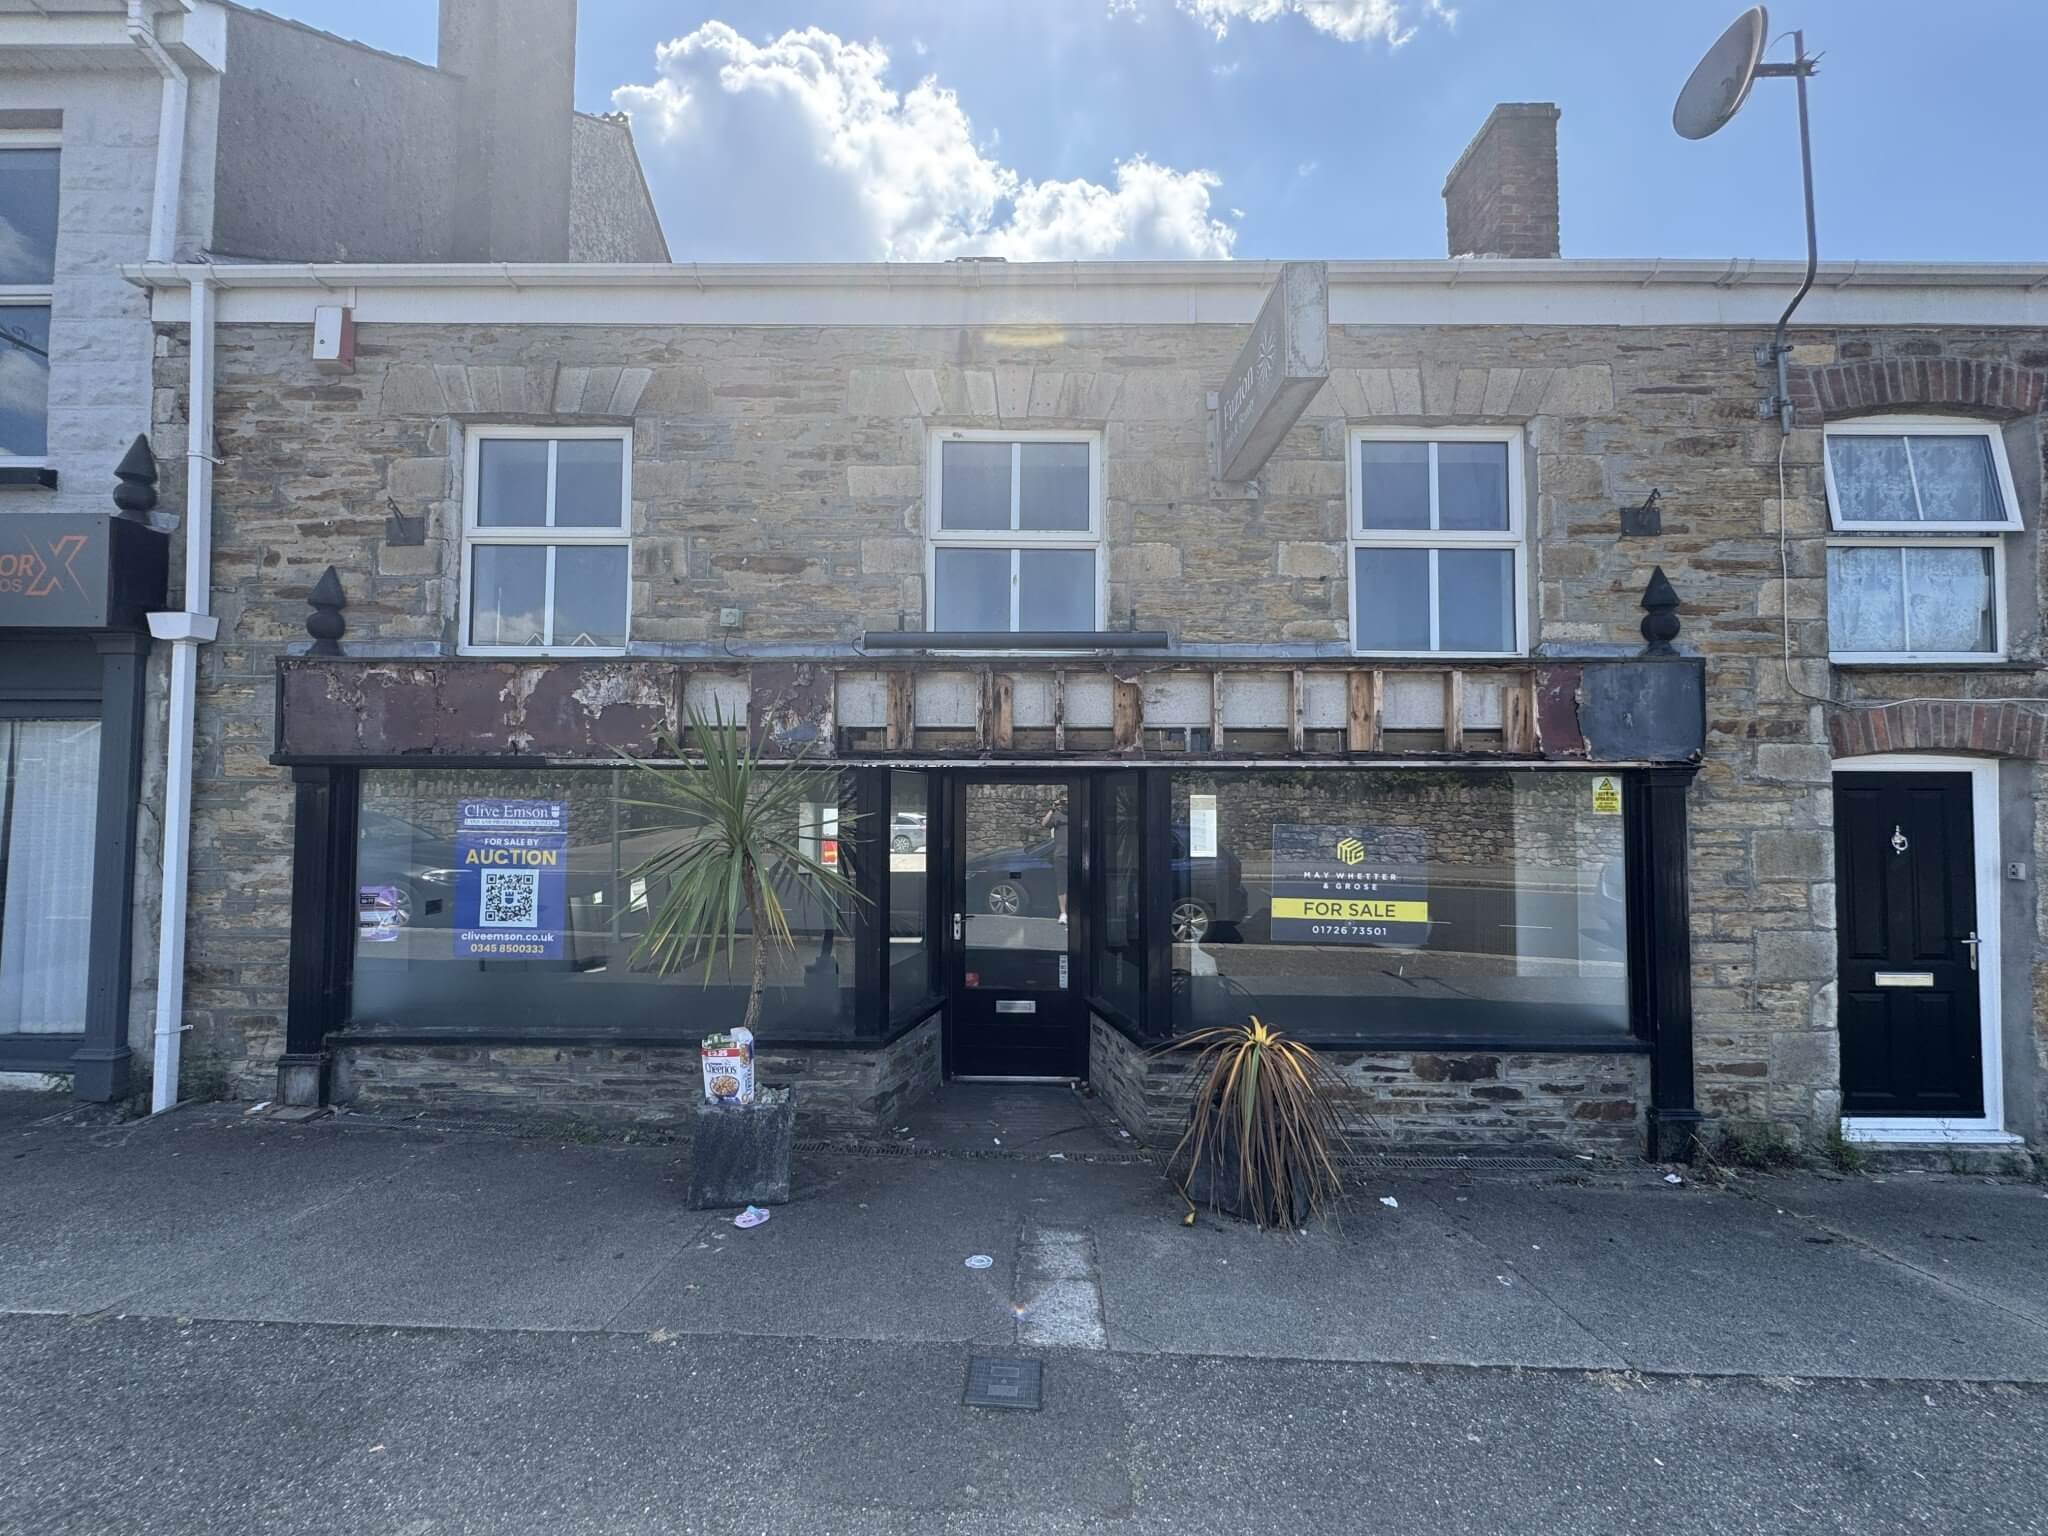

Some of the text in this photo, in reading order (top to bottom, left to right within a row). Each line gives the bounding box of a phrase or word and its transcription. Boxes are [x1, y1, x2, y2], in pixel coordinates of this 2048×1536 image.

[464, 804, 548, 818] Clive Emson
[484, 838, 539, 847] FOR SALE BY
[465, 849, 557, 865] AUCTION
[1303, 871, 1397, 881] MAY WHETTER
[1335, 883, 1378, 891] GROSE
[1304, 902, 1396, 918] FOR SALE
[1312, 925, 1387, 936] 01726 73501
[461, 931, 554, 942] cliveemson.co.uk
[470, 944, 545, 954] 0345 8500333
